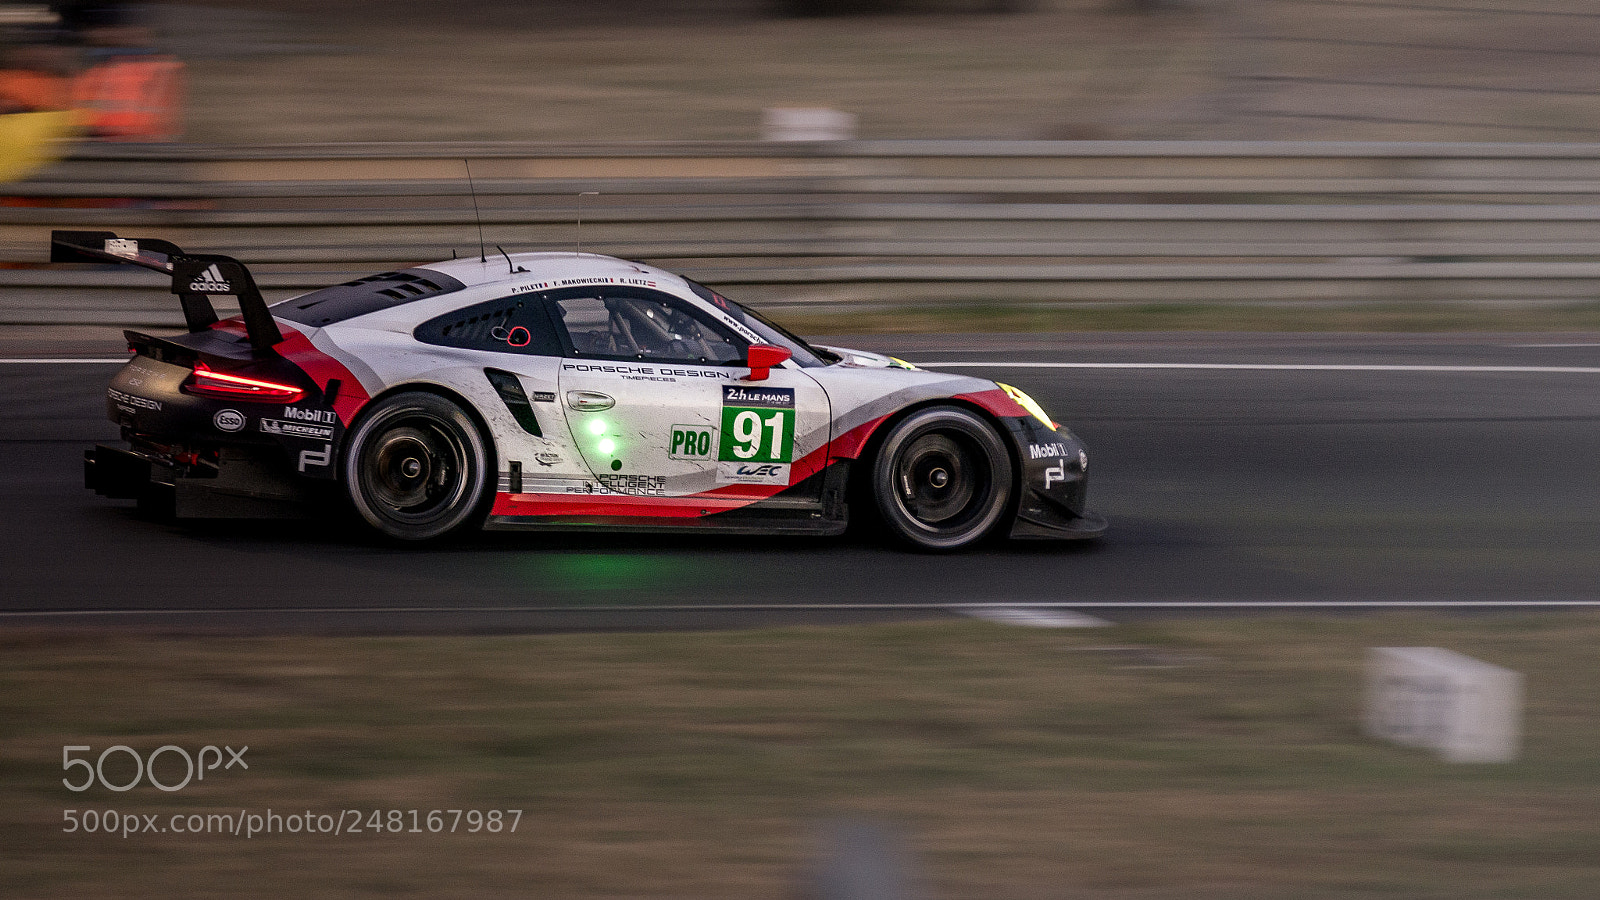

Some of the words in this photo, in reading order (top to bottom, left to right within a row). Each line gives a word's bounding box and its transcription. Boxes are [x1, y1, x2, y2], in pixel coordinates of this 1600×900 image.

[190, 281, 230, 291] adidas
[563, 364, 655, 375] PORSCHE
[660, 368, 730, 379] DESIGN
[622, 375, 677, 383] TIMEPIECES
[131, 396, 163, 411] DESIGN
[761, 394, 790, 402] MANS
[284, 406, 322, 422] Mobil
[220, 415, 239, 426] Esso
[282, 424, 331, 436] MICHELIN
[732, 410, 784, 460] 91
[671, 430, 711, 456] PRO
[1029, 443, 1060, 459] Mobil
[736, 464, 783, 477] WEC
[599, 473, 666, 482] PORSCHE
[582, 480, 666, 488] INTELLIGENT
[566, 486, 666, 496] PERFORMANCE
